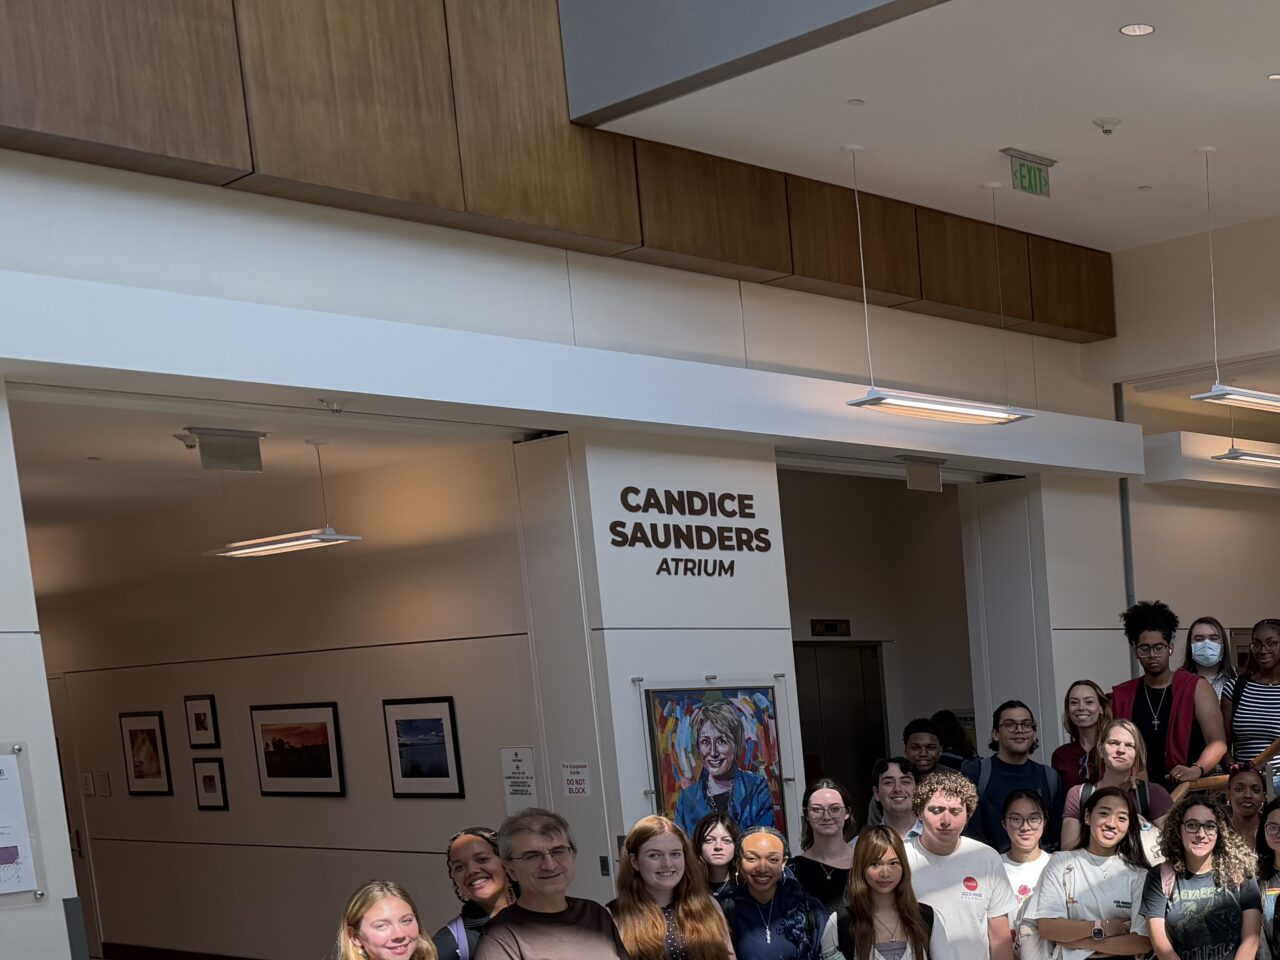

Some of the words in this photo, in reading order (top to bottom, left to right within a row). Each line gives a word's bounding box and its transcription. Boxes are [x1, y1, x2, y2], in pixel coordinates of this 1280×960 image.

[1019, 163, 1043, 195] EXIT
[620, 485, 756, 519] CANDICE
[609, 520, 772, 553] SAUNDERS
[656, 557, 735, 577] ATRIUM
[566, 778, 575, 786] DO
[575, 778, 586, 786] NOT
[568, 787, 587, 795] BLOCK
